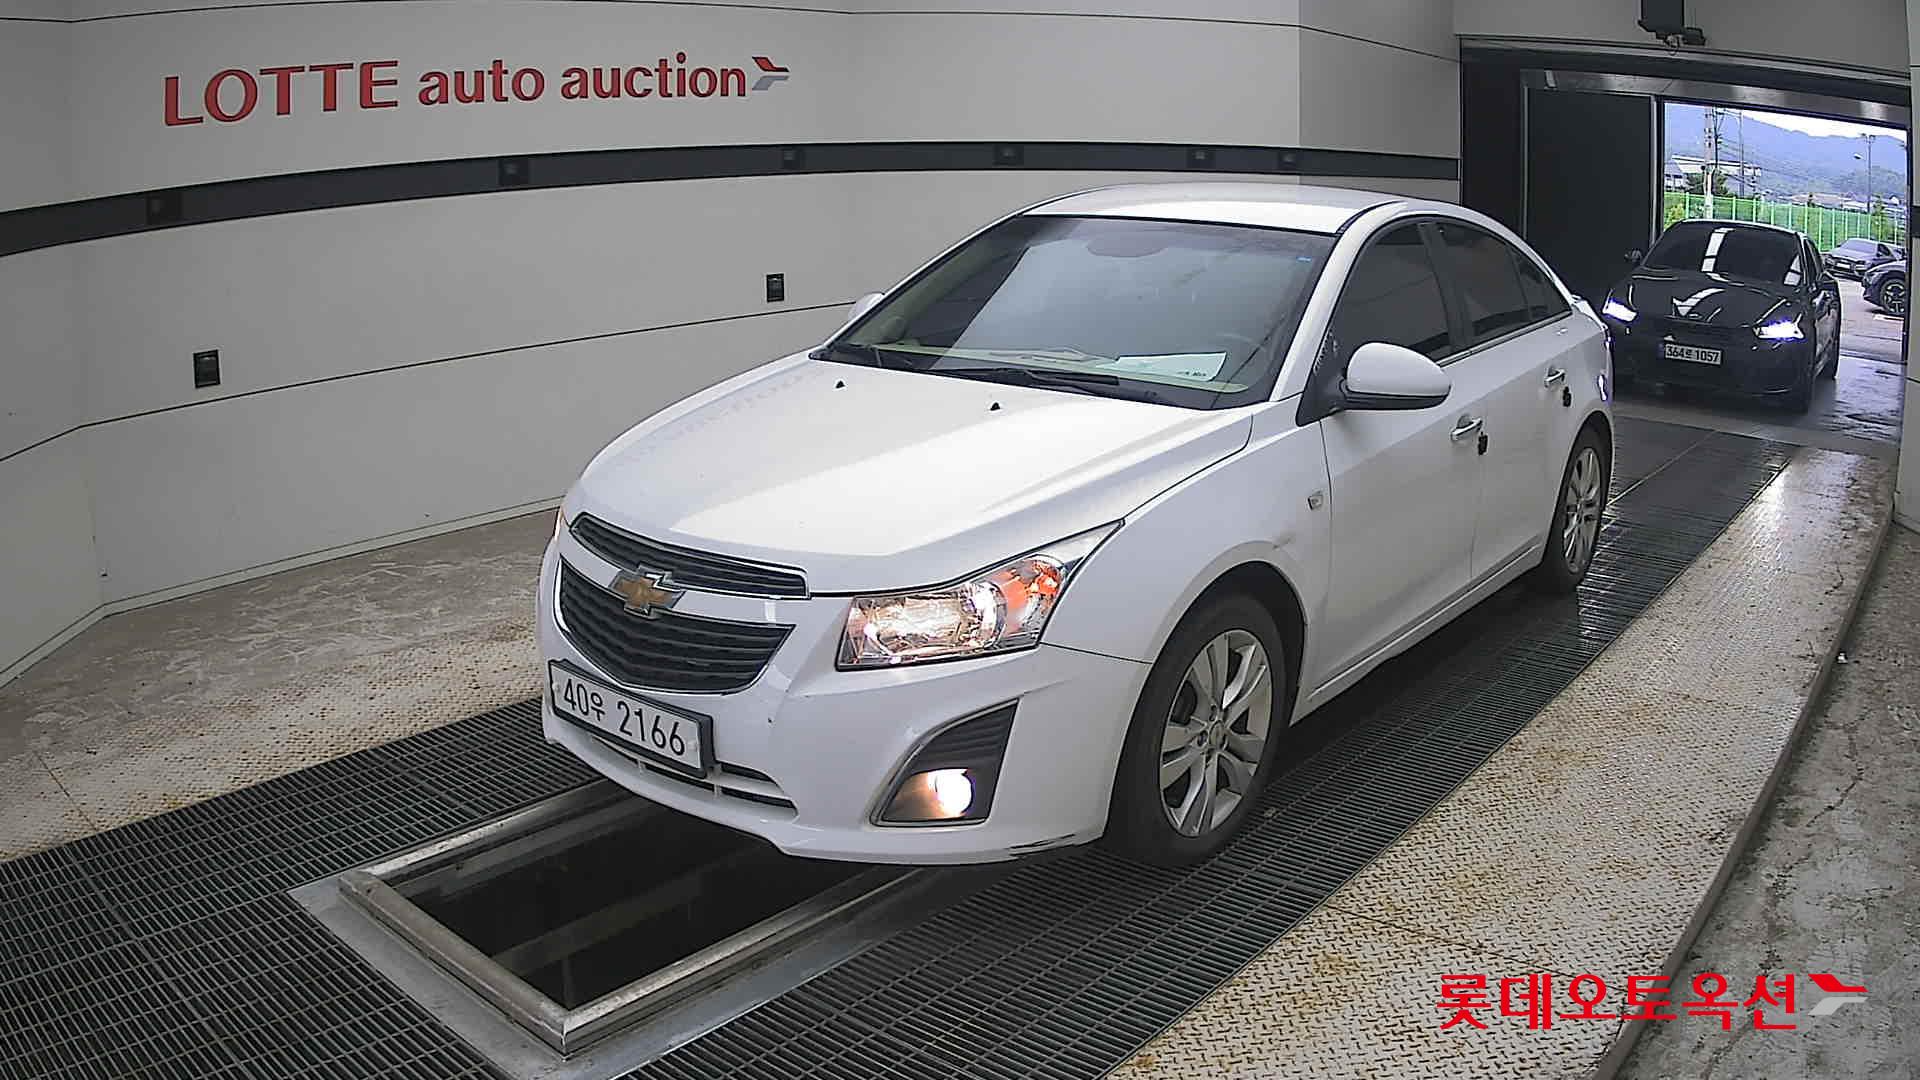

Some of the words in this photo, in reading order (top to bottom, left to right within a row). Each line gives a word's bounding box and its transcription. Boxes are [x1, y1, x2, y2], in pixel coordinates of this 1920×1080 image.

[163, 59, 399, 127] LOTTE
[417, 59, 545, 106] auto
[560, 51, 746, 99] auction
[1695, 350, 1719, 362] 1057
[564, 678, 605, 721] 40우
[617, 700, 685, 756] 2166
